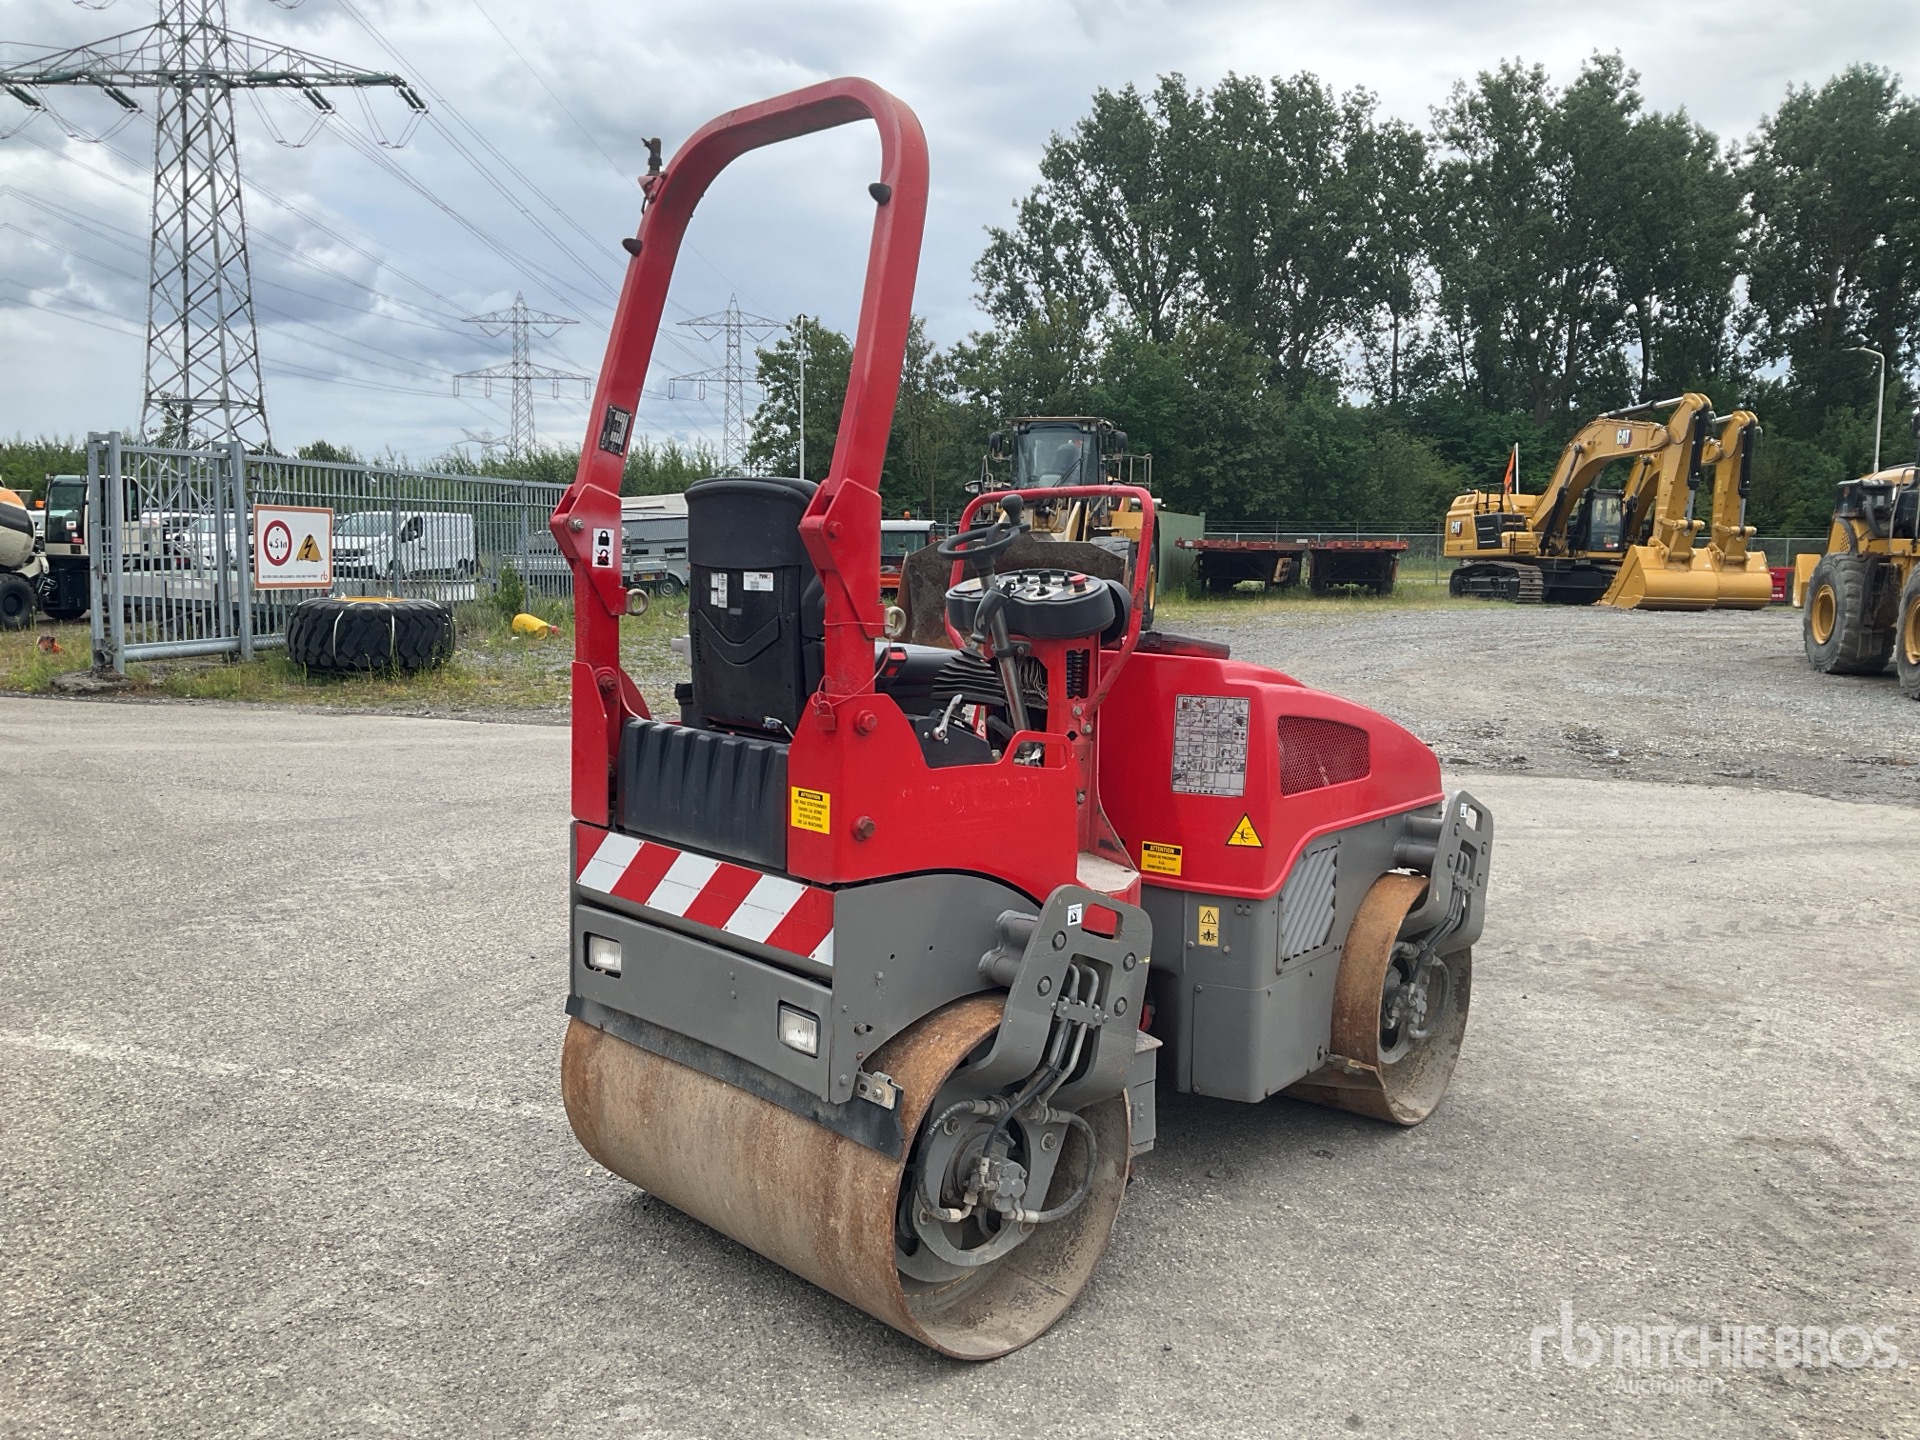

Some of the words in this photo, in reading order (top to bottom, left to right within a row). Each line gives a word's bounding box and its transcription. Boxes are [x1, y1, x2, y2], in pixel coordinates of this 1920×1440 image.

[1617, 429, 1631, 445] CAT
[1450, 521, 1461, 534] CAT
[321, 571, 328, 580] rb
[1150, 845, 1175, 854] ATTENTION
